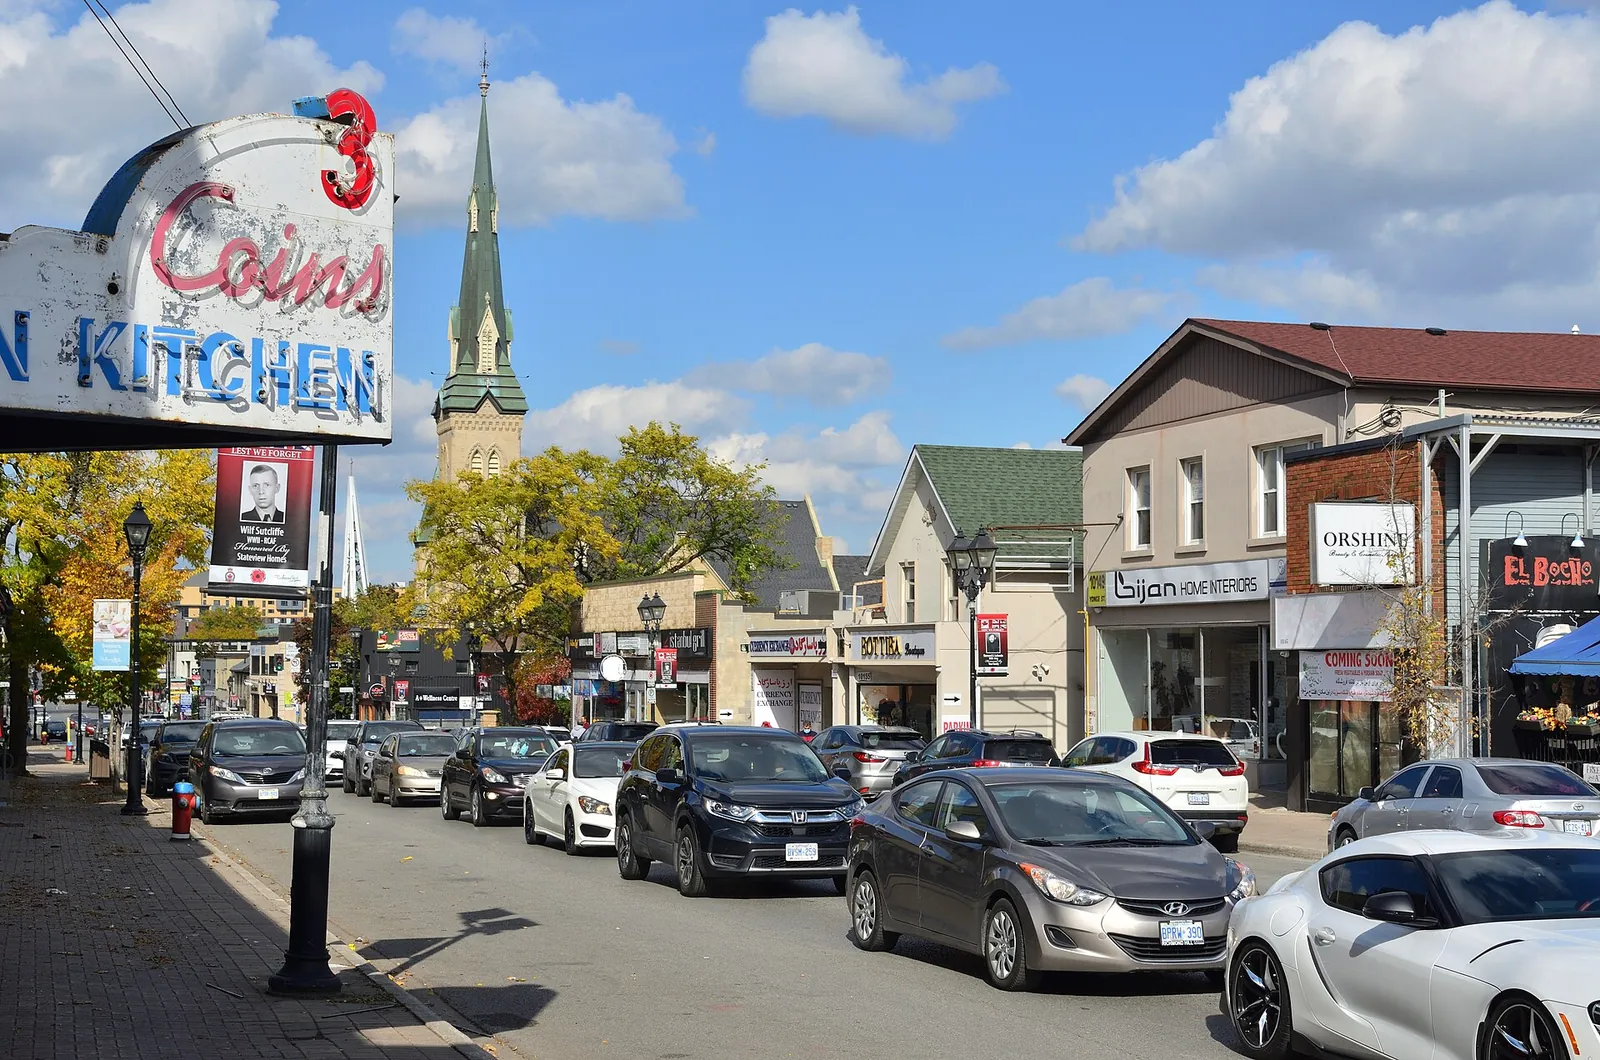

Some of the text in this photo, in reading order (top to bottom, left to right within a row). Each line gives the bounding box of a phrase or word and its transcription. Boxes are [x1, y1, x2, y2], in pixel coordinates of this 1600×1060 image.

[321, 88, 377, 209] 3
[150, 181, 385, 313] Coins
[79, 317, 381, 418] KITCHEN
[231, 447, 302, 458] LEST WE FORGET
[240, 526, 284, 536] Wilf Sutcliffe
[264, 536, 277, 544] RCAF
[234, 542, 290, 558] Honoured By
[236, 552, 287, 564] Stateview Homes
[1180, 580, 1208, 596] HOME
[1210, 577, 1258, 594] INTERIORS
[1325, 652, 1394, 667] COMING SOON
